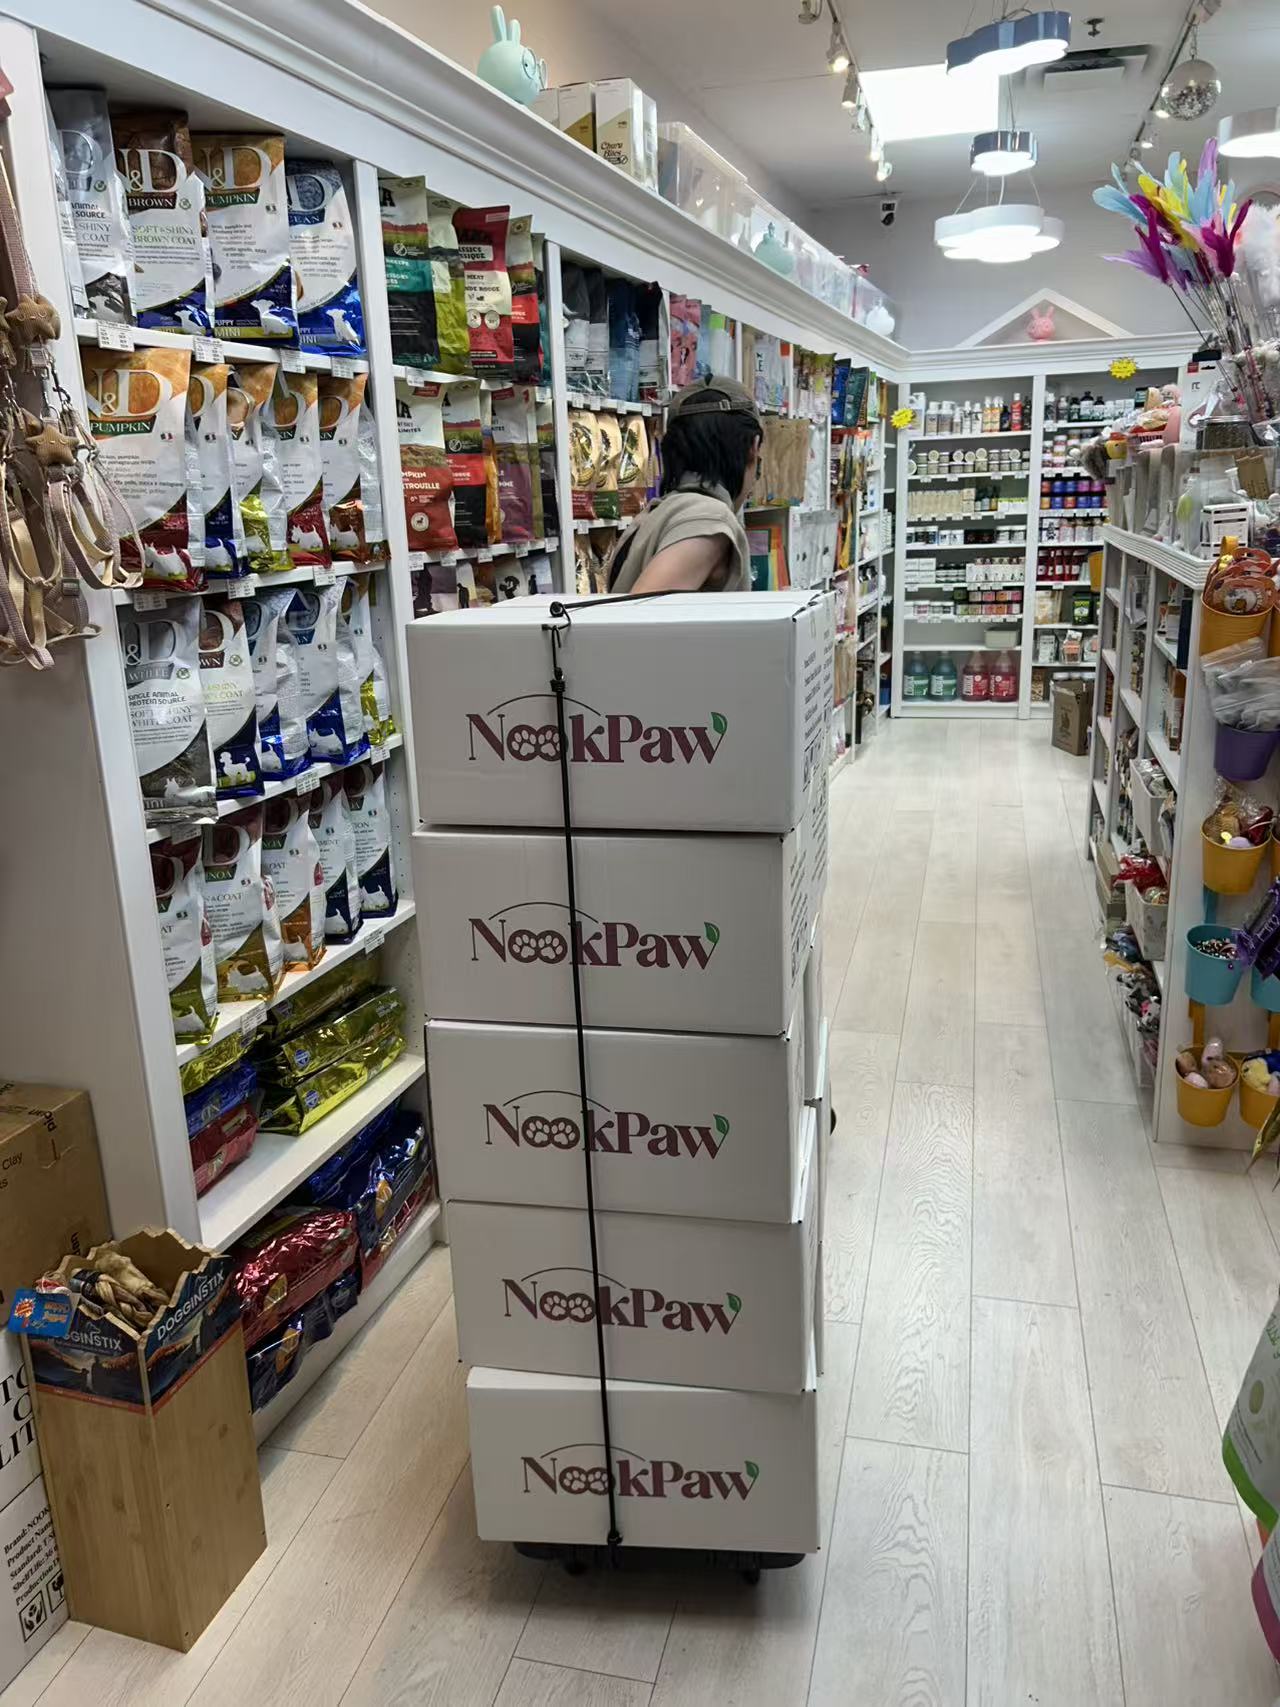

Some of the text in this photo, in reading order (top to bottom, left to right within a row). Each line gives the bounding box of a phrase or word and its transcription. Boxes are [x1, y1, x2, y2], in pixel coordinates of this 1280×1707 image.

[128, 197, 174, 208] BROWN
[207, 193, 257, 205] PUMPKIN
[82, 233, 112, 243] COAT
[214, 327, 241, 337] MINI
[90, 421, 152, 433] PUMPKIN
[465, 711, 728, 764] NookPaw
[468, 918, 721, 970] NookPaw
[483, 1103, 730, 1160] NookPaw
[2, 1152, 23, 1170] Clay
[157, 1269, 225, 1341] DOGGINSTIX
[501, 1278, 742, 1335] NookPaw
[521, 1456, 760, 1501] NookPaw
[4, 1528, 29, 1554] Brand:
[7, 1537, 35, 1567] Product
[10, 1545, 43, 1579] Standard:
[16, 1565, 54, 1606] Production
